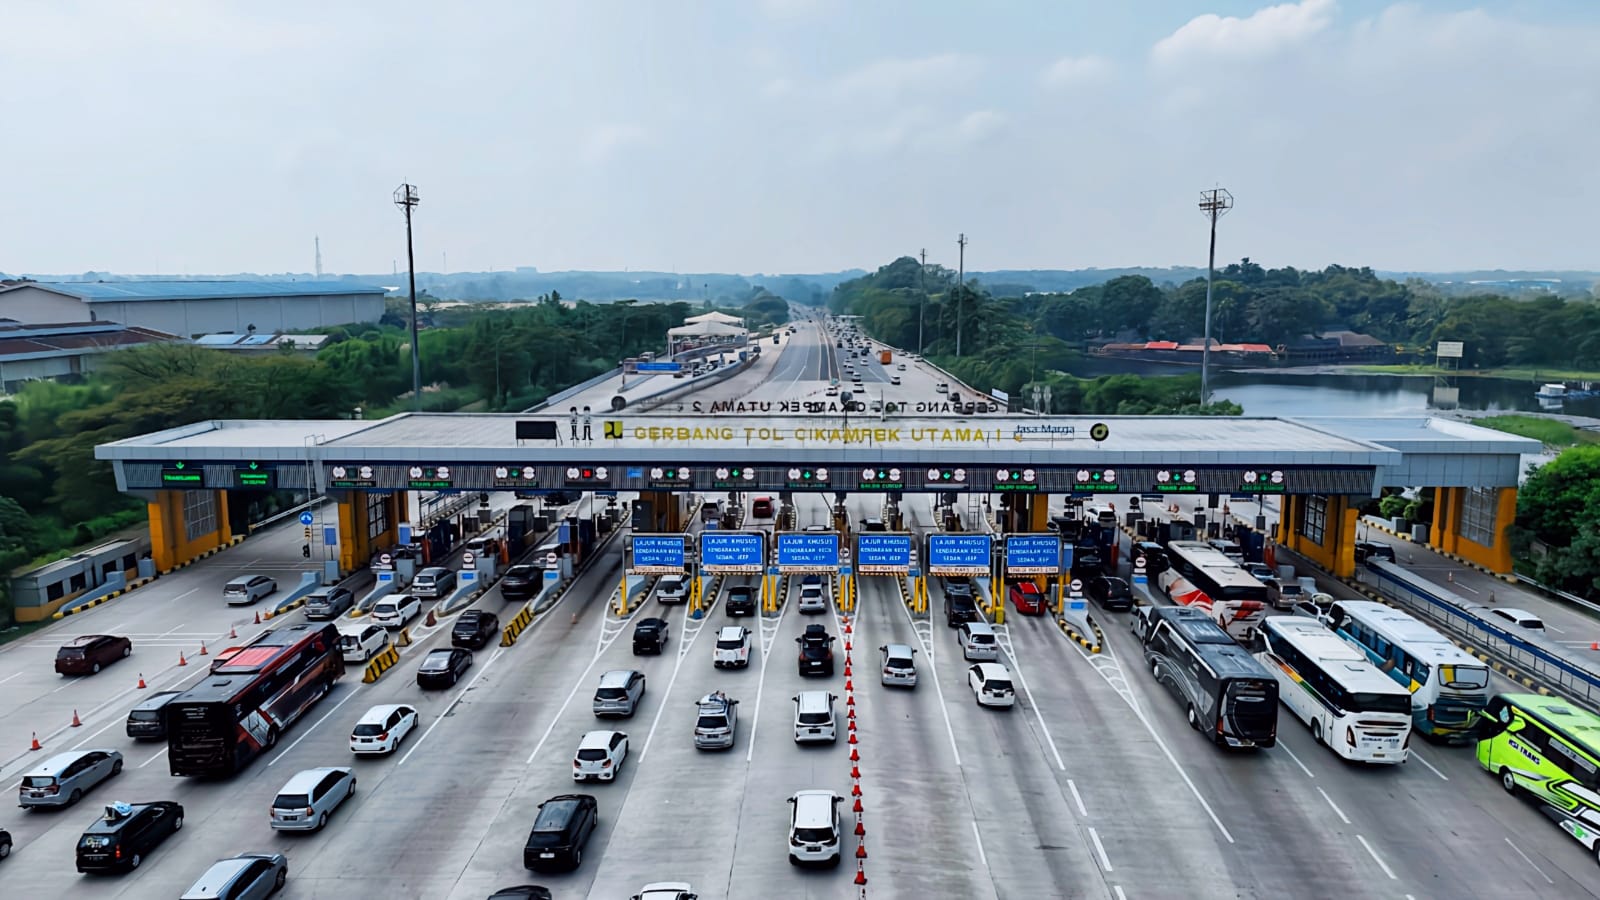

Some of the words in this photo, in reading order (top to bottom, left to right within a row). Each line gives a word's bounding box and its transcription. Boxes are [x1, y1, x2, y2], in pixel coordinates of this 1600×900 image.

[634, 427, 733, 440] GERBANG
[744, 427, 784, 440] TOL
[795, 428, 900, 442] CIKAMPEK
[912, 428, 985, 441] UTAMA
[1016, 425, 1038, 434] Jasa
[1042, 425, 1075, 435] Marga
